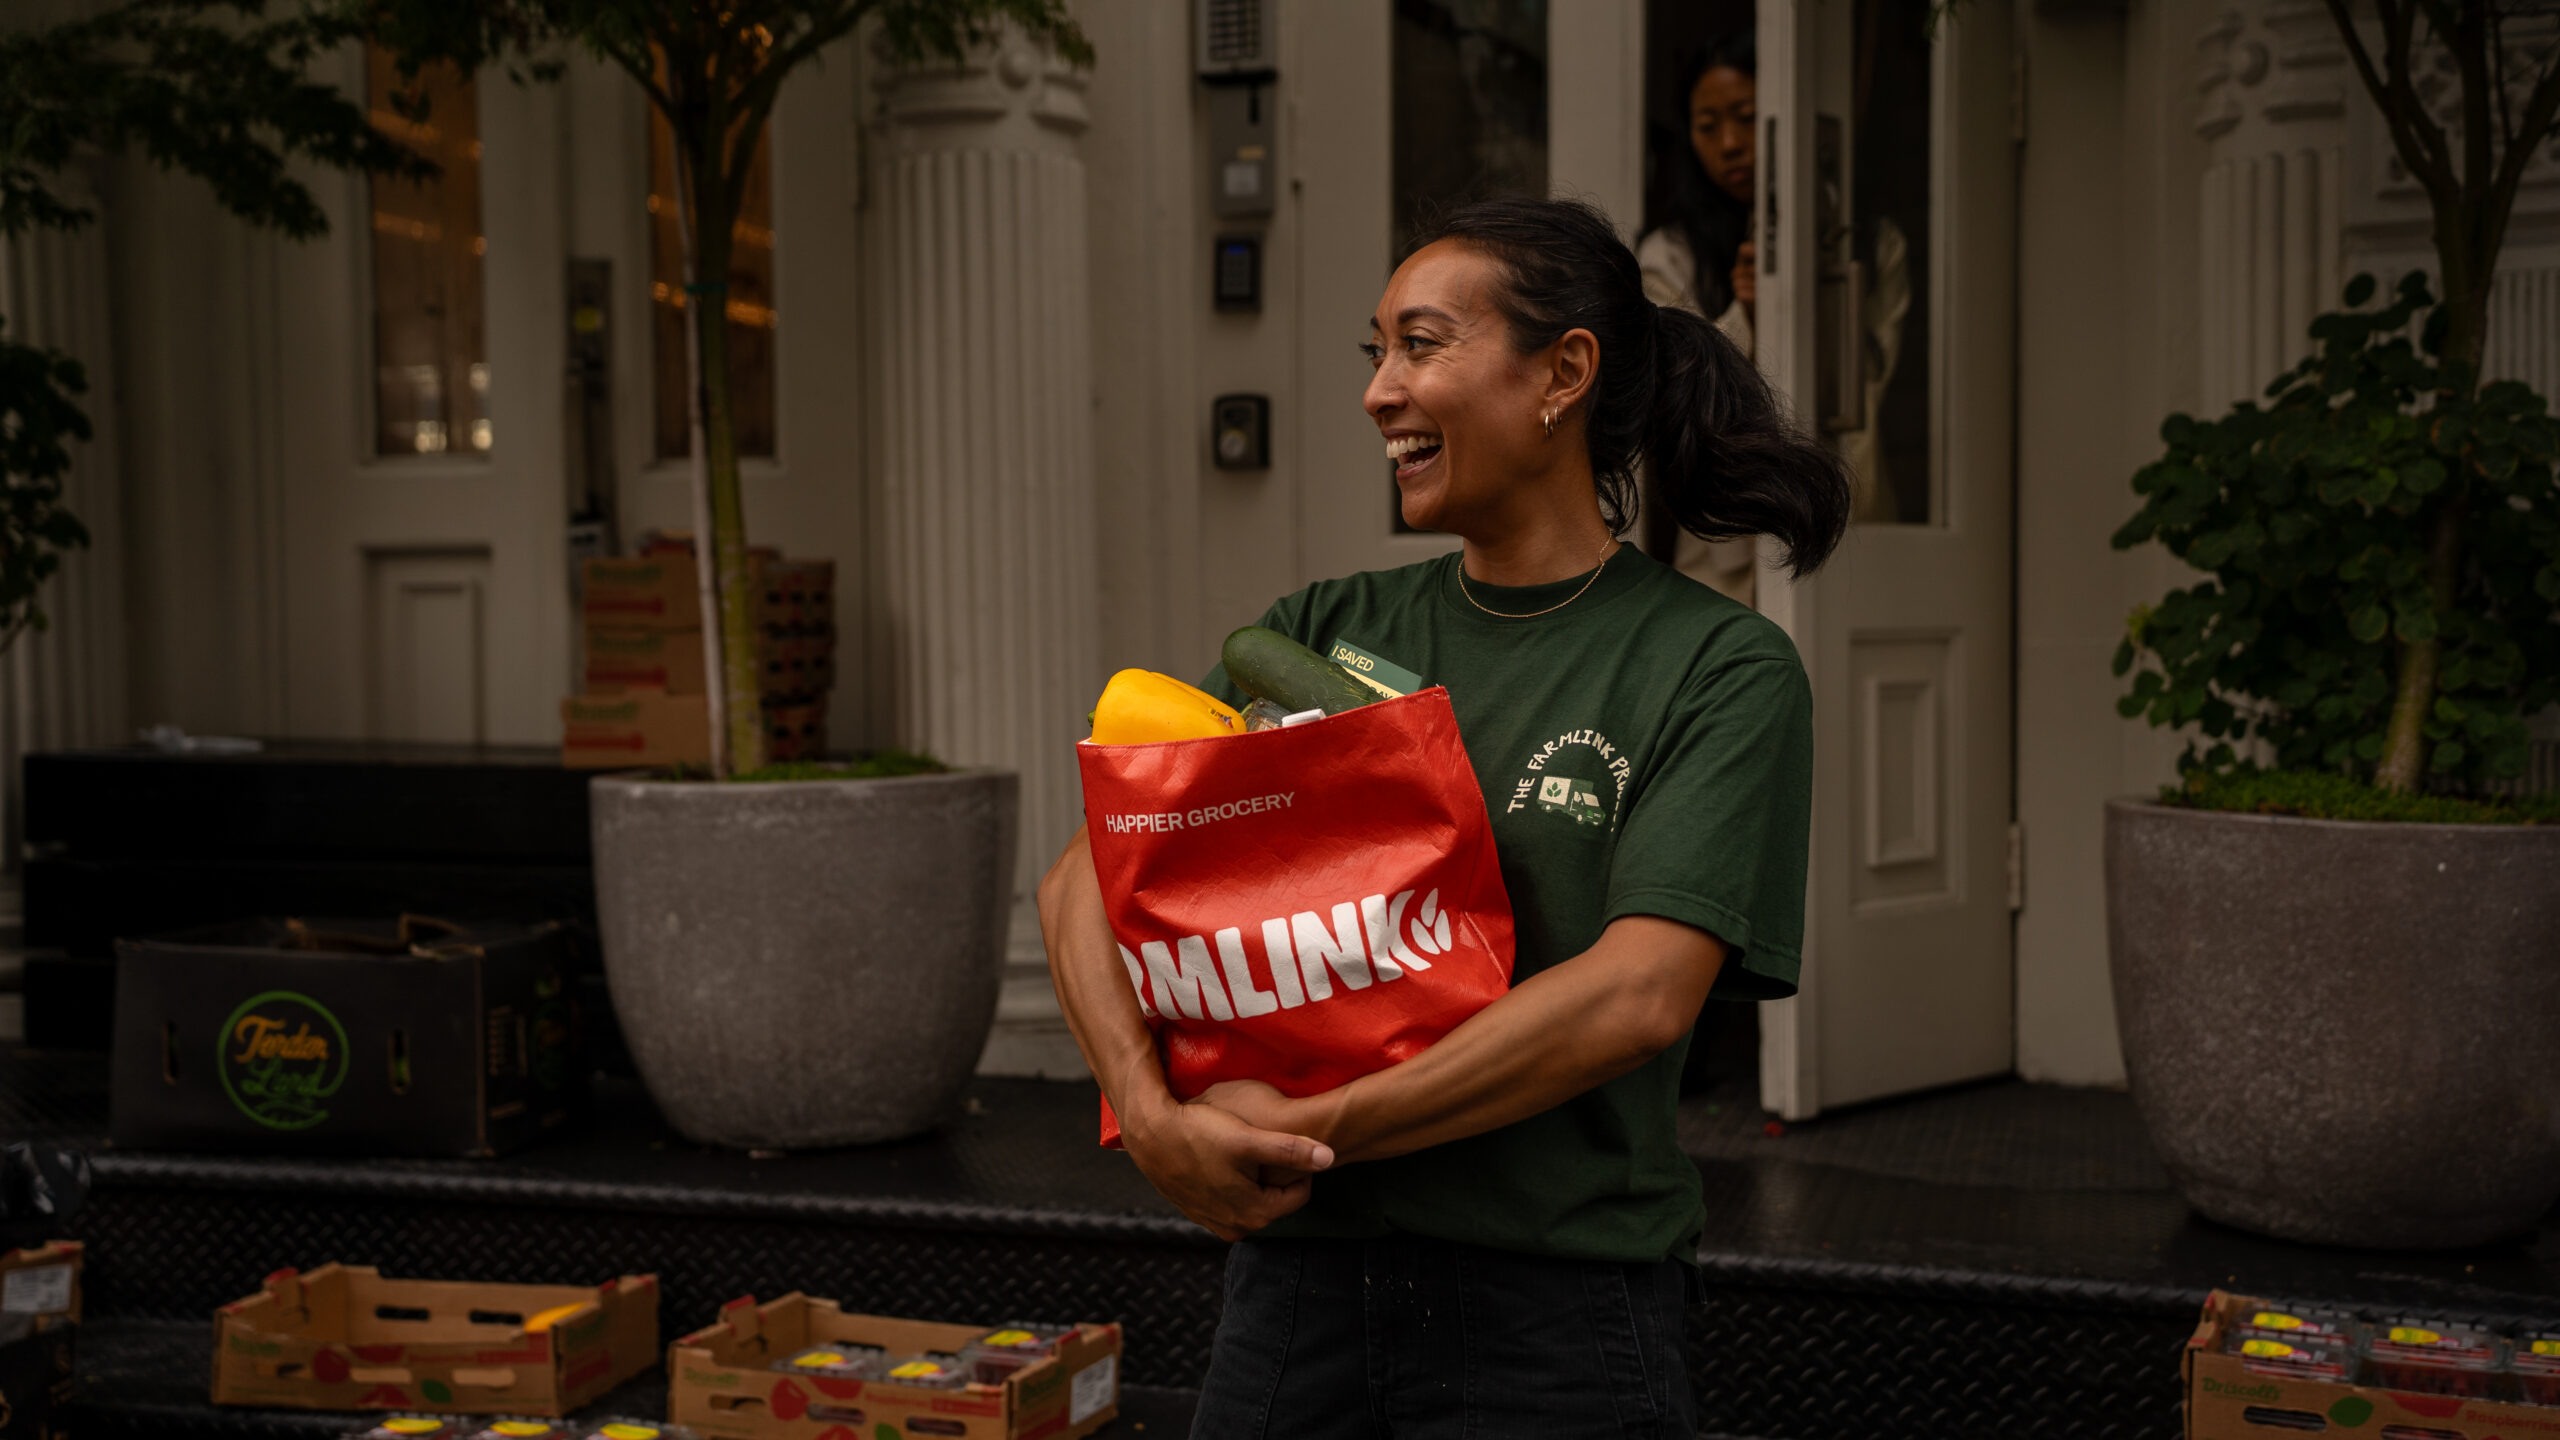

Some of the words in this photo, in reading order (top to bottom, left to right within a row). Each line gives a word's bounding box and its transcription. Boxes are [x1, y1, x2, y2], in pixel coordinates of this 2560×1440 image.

[1331, 644, 1339, 657] I
[1336, 647, 1374, 672] SAVED
[1507, 777, 1536, 814] THE
[1527, 729, 1616, 771] FARMLINK
[1105, 812, 1185, 833] HAPPIER
[1186, 791, 1296, 827] GROCERY
